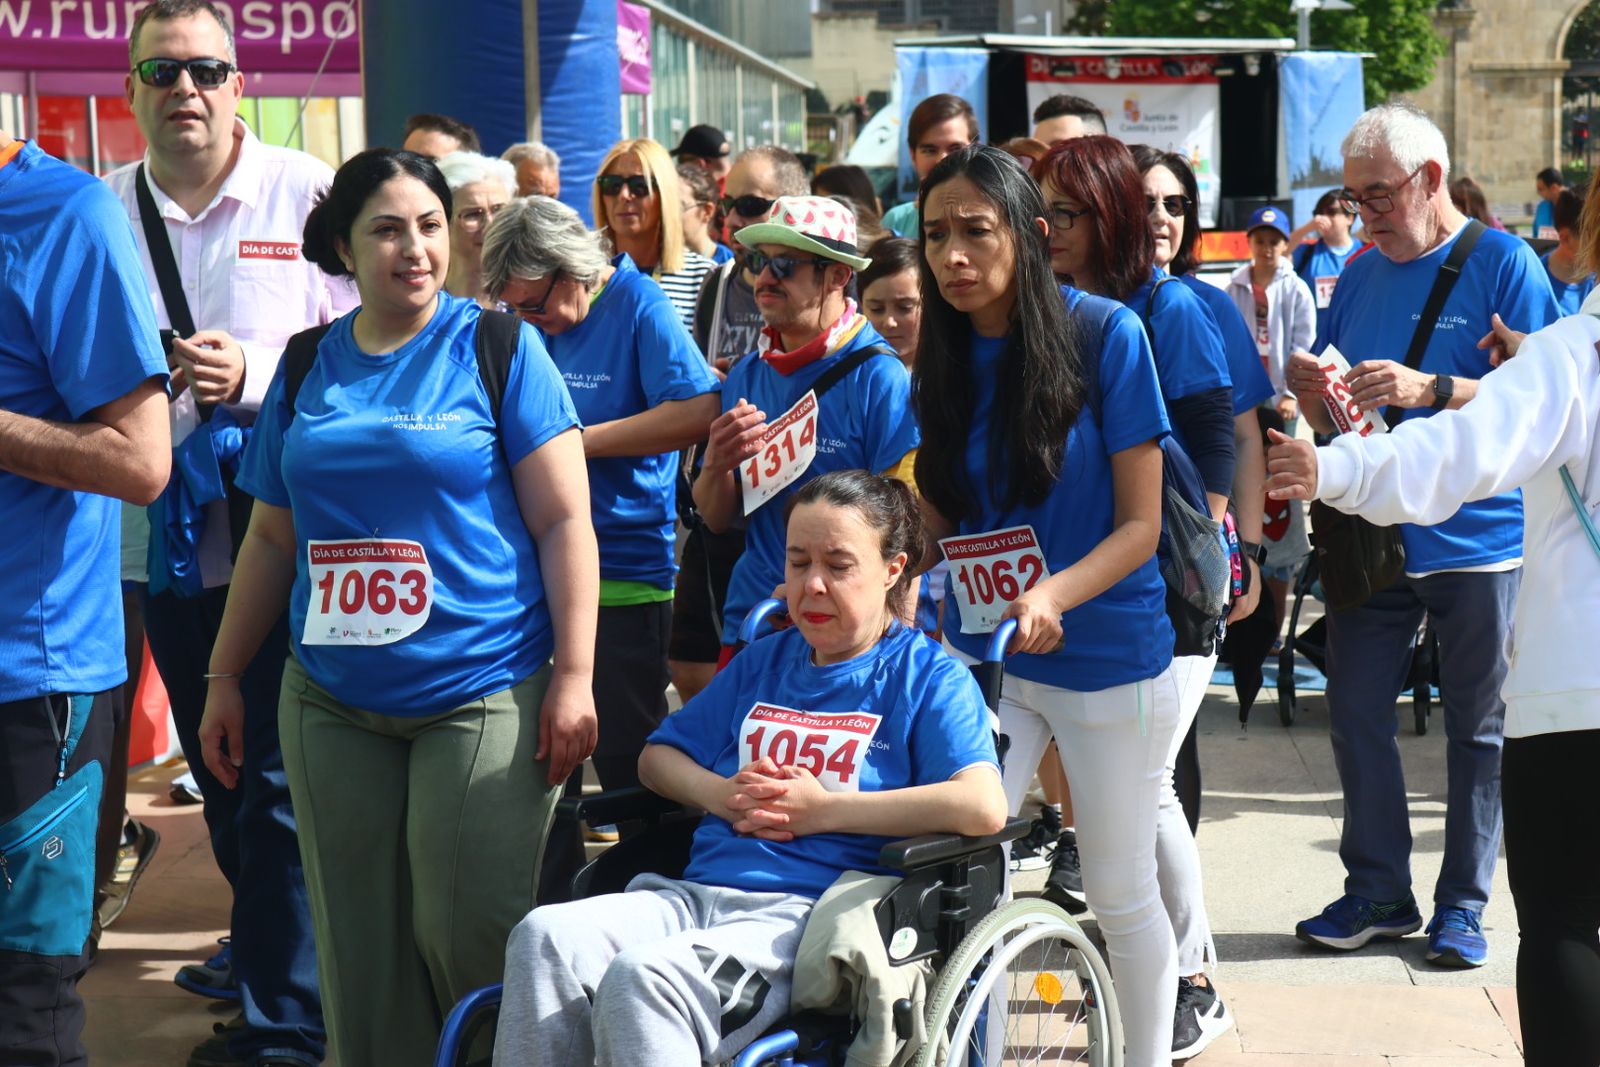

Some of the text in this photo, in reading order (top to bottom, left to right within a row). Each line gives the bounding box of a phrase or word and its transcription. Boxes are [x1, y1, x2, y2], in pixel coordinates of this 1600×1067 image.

[242, 243, 259, 254] DÍA
[261, 246, 274, 255] DE
[1450, 315, 1467, 325] LEÓN
[586, 374, 592, 382] Y
[593, 372, 611, 382] LEÓN
[796, 399, 814, 418] LEÓN
[382, 411, 462, 423] CASTILLA Y LEÓN
[829, 439, 847, 448] LEÓN
[746, 416, 815, 489] 1314
[313, 546, 421, 559] DÍA DE CASTILLA Y LEÓN
[946, 534, 1031, 555] DÍA DE CASTILLA Y LEÓN
[958, 553, 1043, 605] 1062
[318, 569, 427, 616] 1063
[755, 709, 872, 730] DÍA DE CASTILLA Y LEÓN
[868, 739, 890, 750] EÓN
[746, 726, 859, 783] 1054
